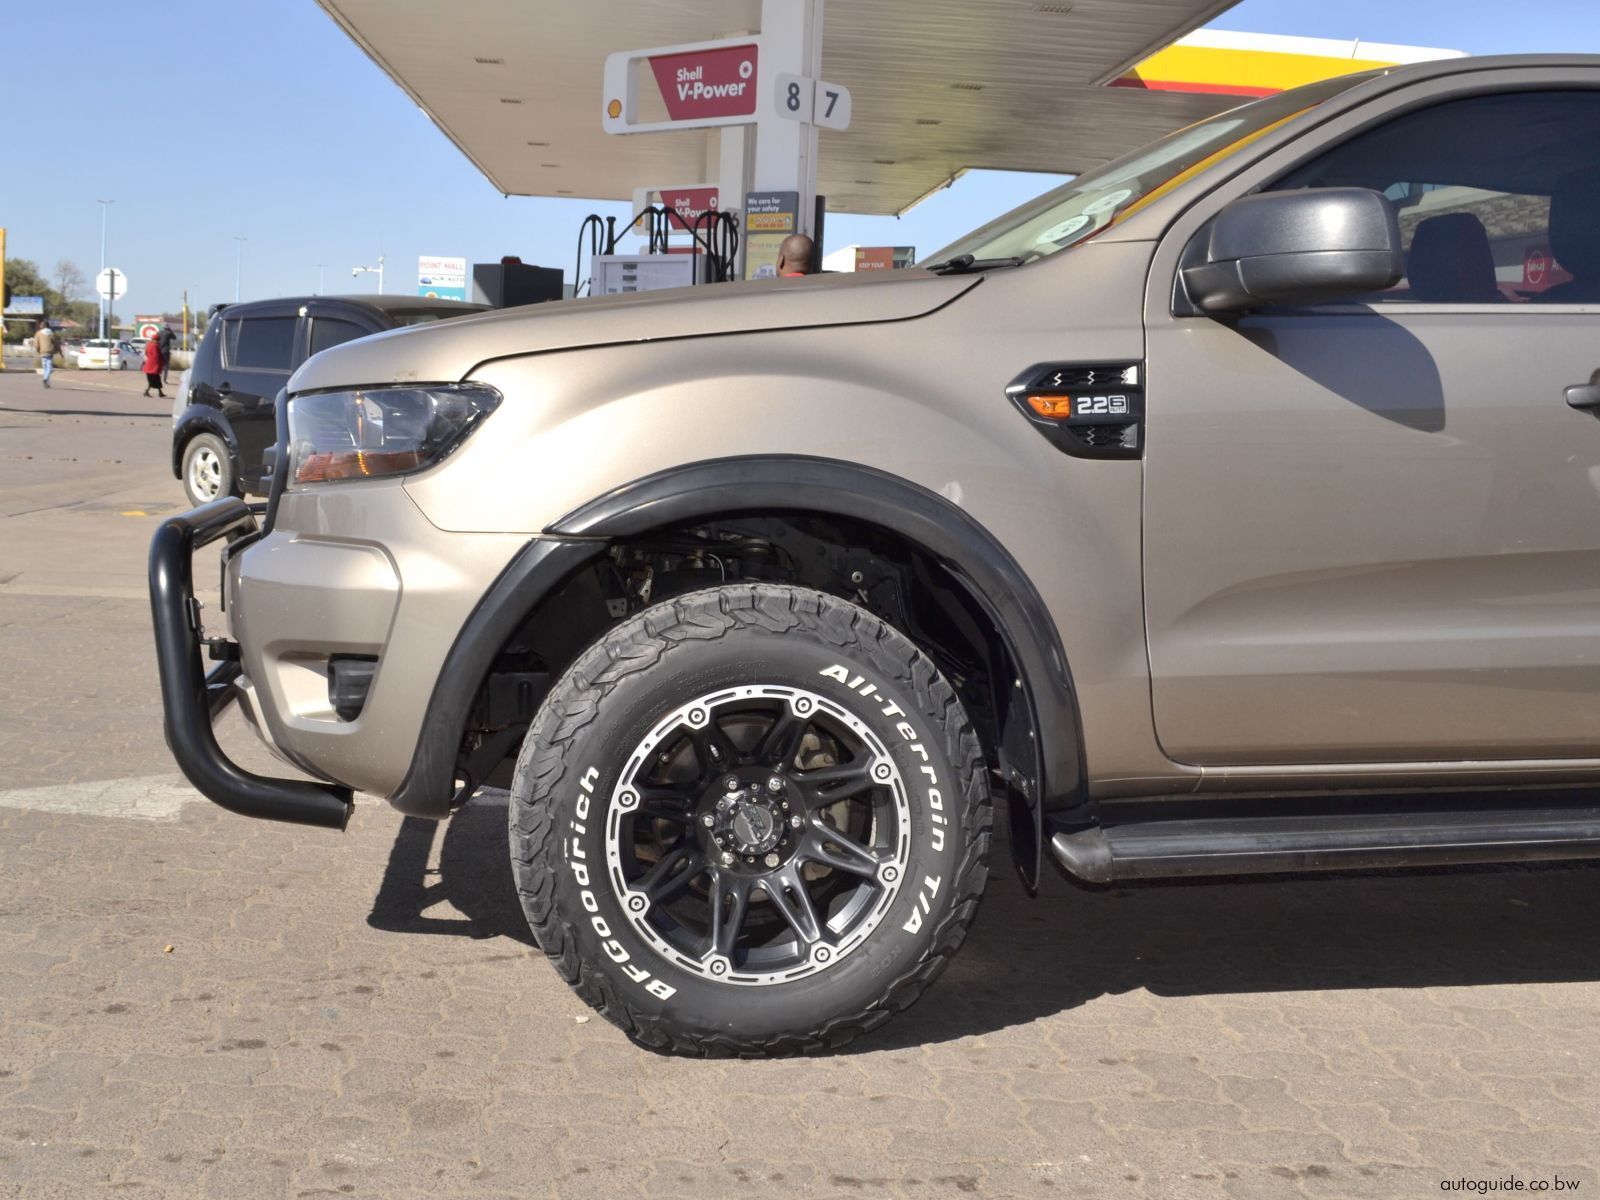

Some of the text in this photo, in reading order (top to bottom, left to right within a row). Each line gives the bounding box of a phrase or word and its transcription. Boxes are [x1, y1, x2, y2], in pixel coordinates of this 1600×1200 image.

[677, 66, 702, 81] Shell
[677, 82, 746, 101] V-Power
[787, 83, 800, 111] 8
[825, 91, 839, 118] 7
[675, 199, 690, 207] Shell
[820, 664, 948, 934] All-Terrain T/A
[571, 766, 677, 1000] BFGoodrich
